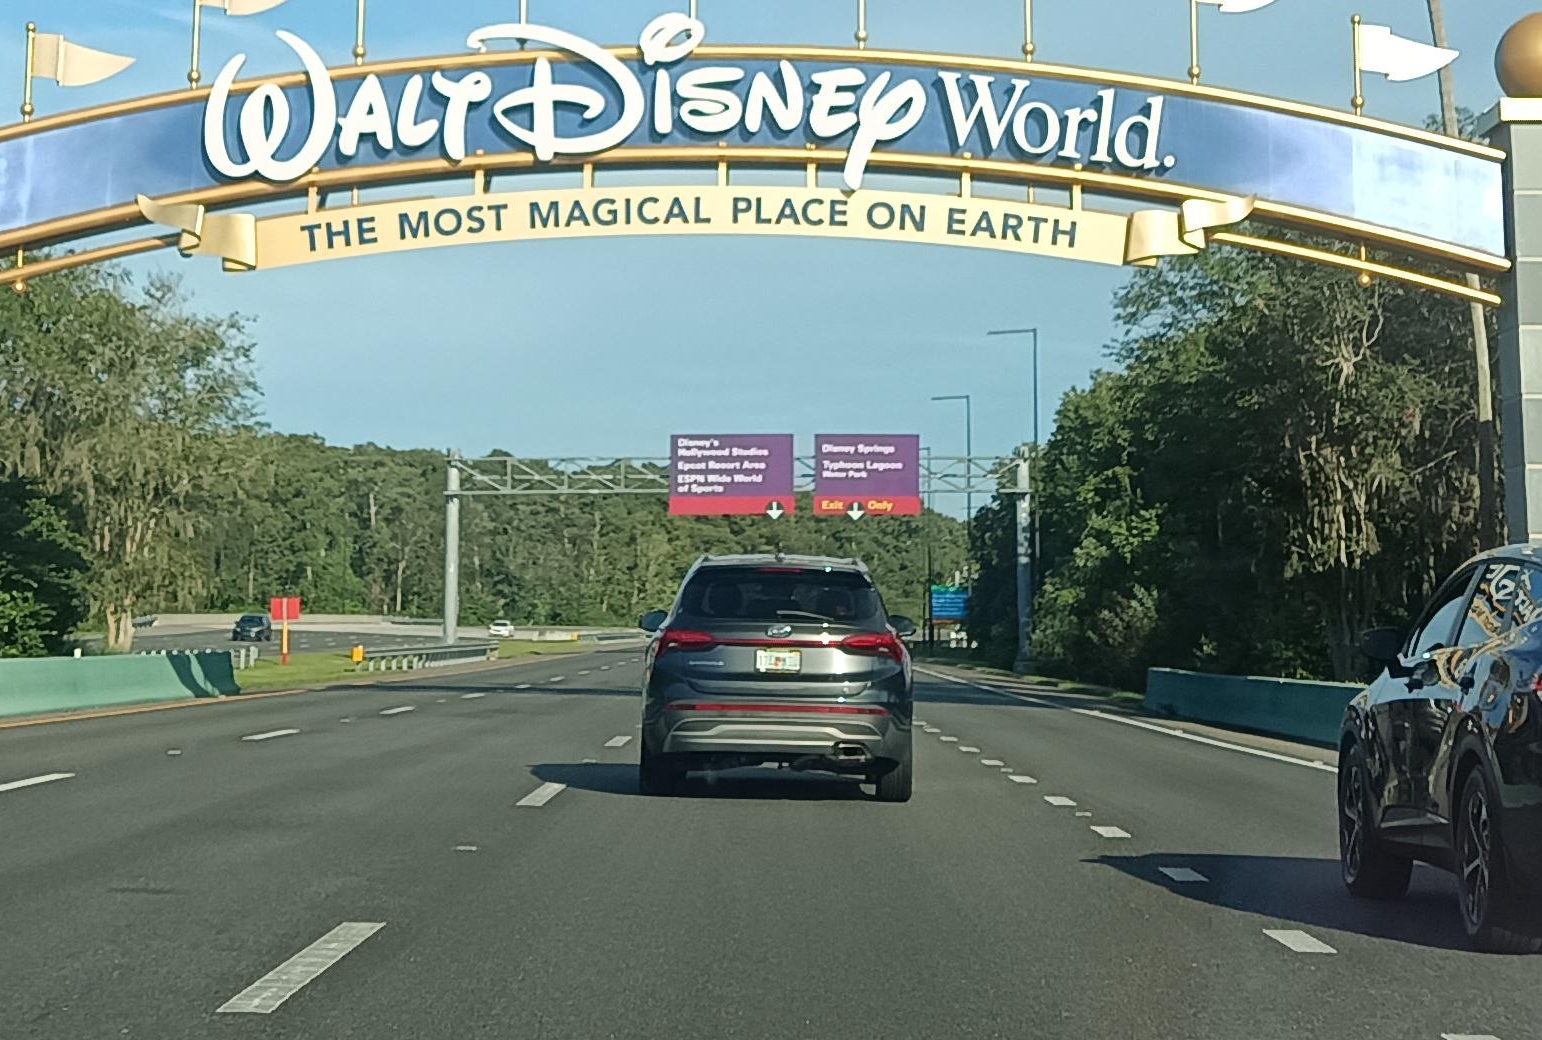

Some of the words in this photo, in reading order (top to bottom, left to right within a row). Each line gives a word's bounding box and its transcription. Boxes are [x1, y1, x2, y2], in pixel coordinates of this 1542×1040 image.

[299, 220, 380, 255] THE
[396, 208, 509, 240] MOST
[528, 198, 713, 228] MAGICAL
[731, 197, 851, 228] PLACE
[865, 203, 929, 231] ON
[945, 210, 1080, 250] EARTH
[678, 438, 719, 448] Disney's
[822, 444, 855, 454] Disney
[857, 444, 895, 454] Springs
[742, 461, 766, 470] Area
[822, 460, 865, 471] Typhoon
[866, 460, 903, 471] Lagoon
[678, 484, 689, 492] of
[690, 484, 724, 493] Sports
[821, 500, 844, 510] Exit
[867, 500, 893, 512] Only
